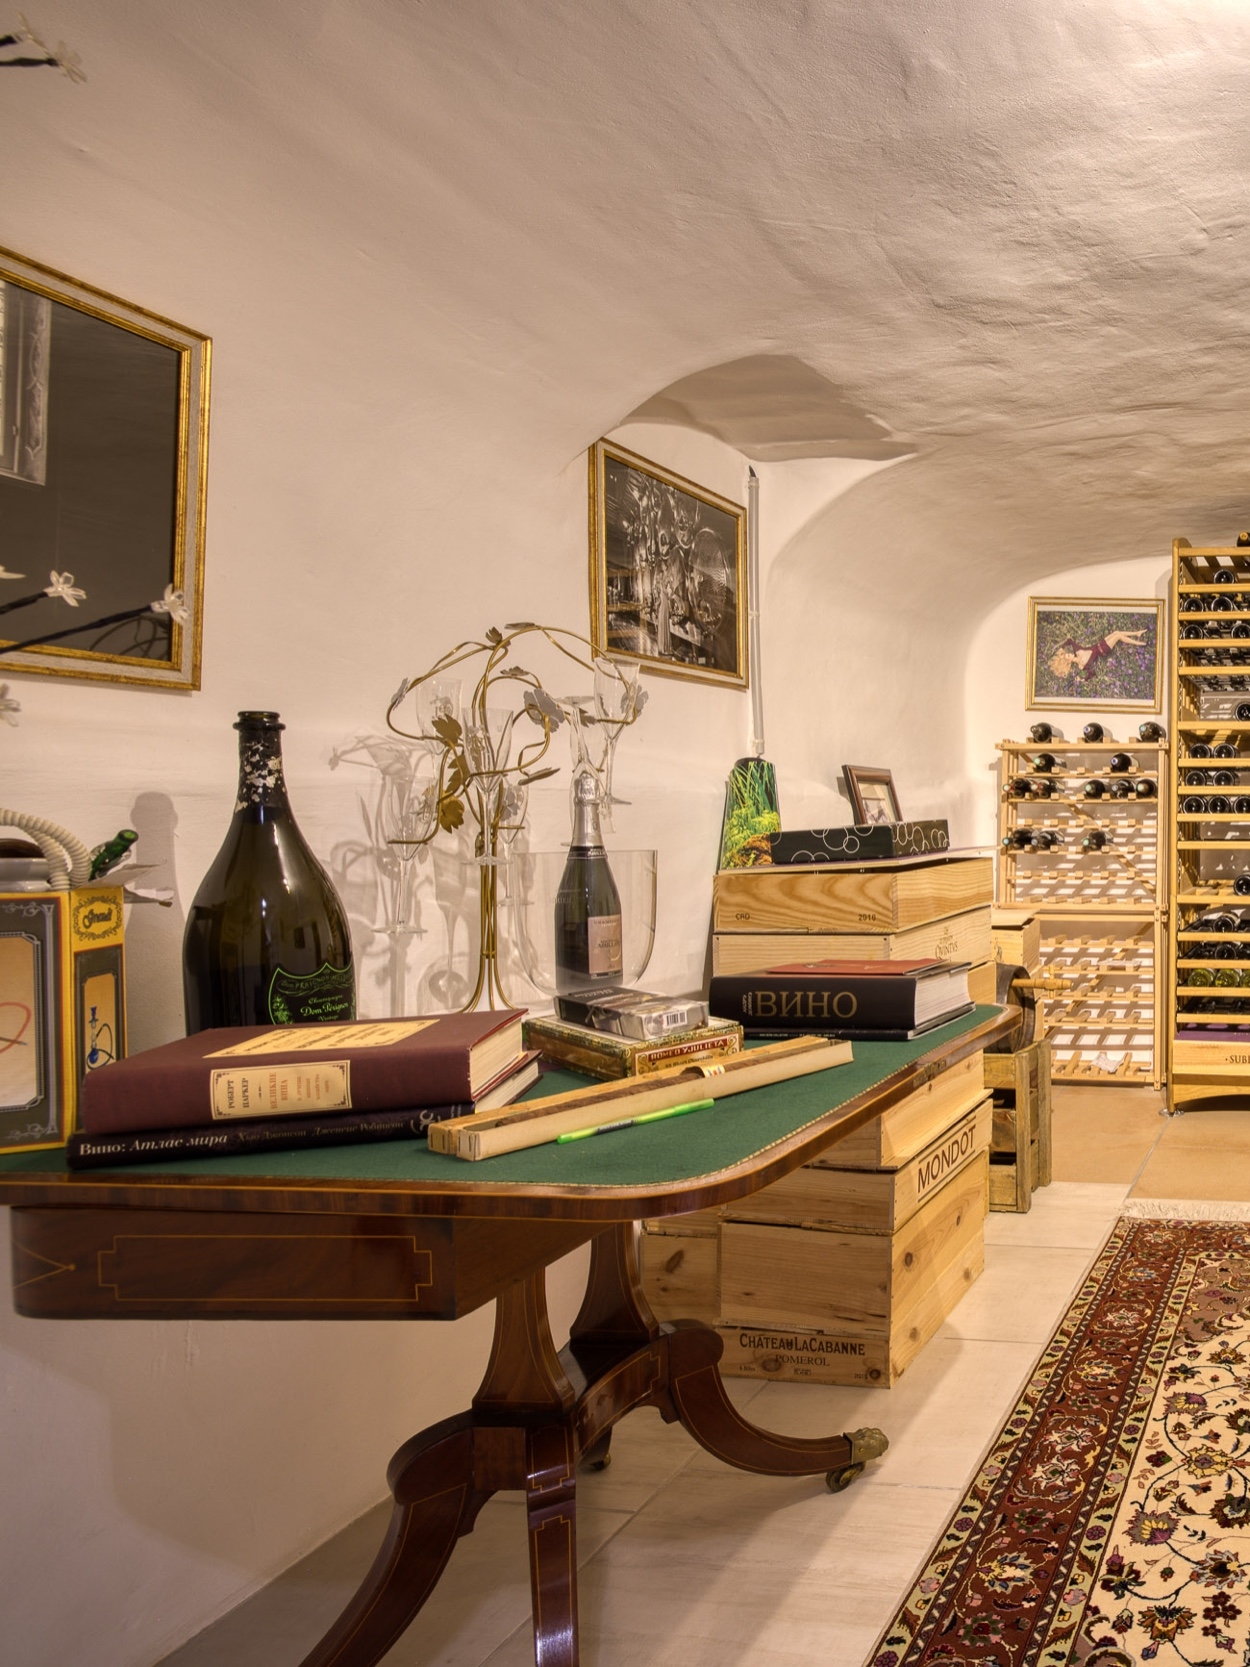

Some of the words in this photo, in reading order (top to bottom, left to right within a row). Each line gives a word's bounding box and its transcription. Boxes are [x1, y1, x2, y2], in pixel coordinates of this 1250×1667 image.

[754, 991, 858, 1018] ВИНО
[227, 1079, 235, 1109] РОБЕРТ
[241, 1077, 250, 1108] ПАРКЕР
[79, 1142, 126, 1156] Вино:
[129, 1138, 183, 1151] Атлас
[186, 1134, 228, 1148] мира
[917, 1124, 976, 1194] MONDOT
[775, 1354, 831, 1367] POMEROL
